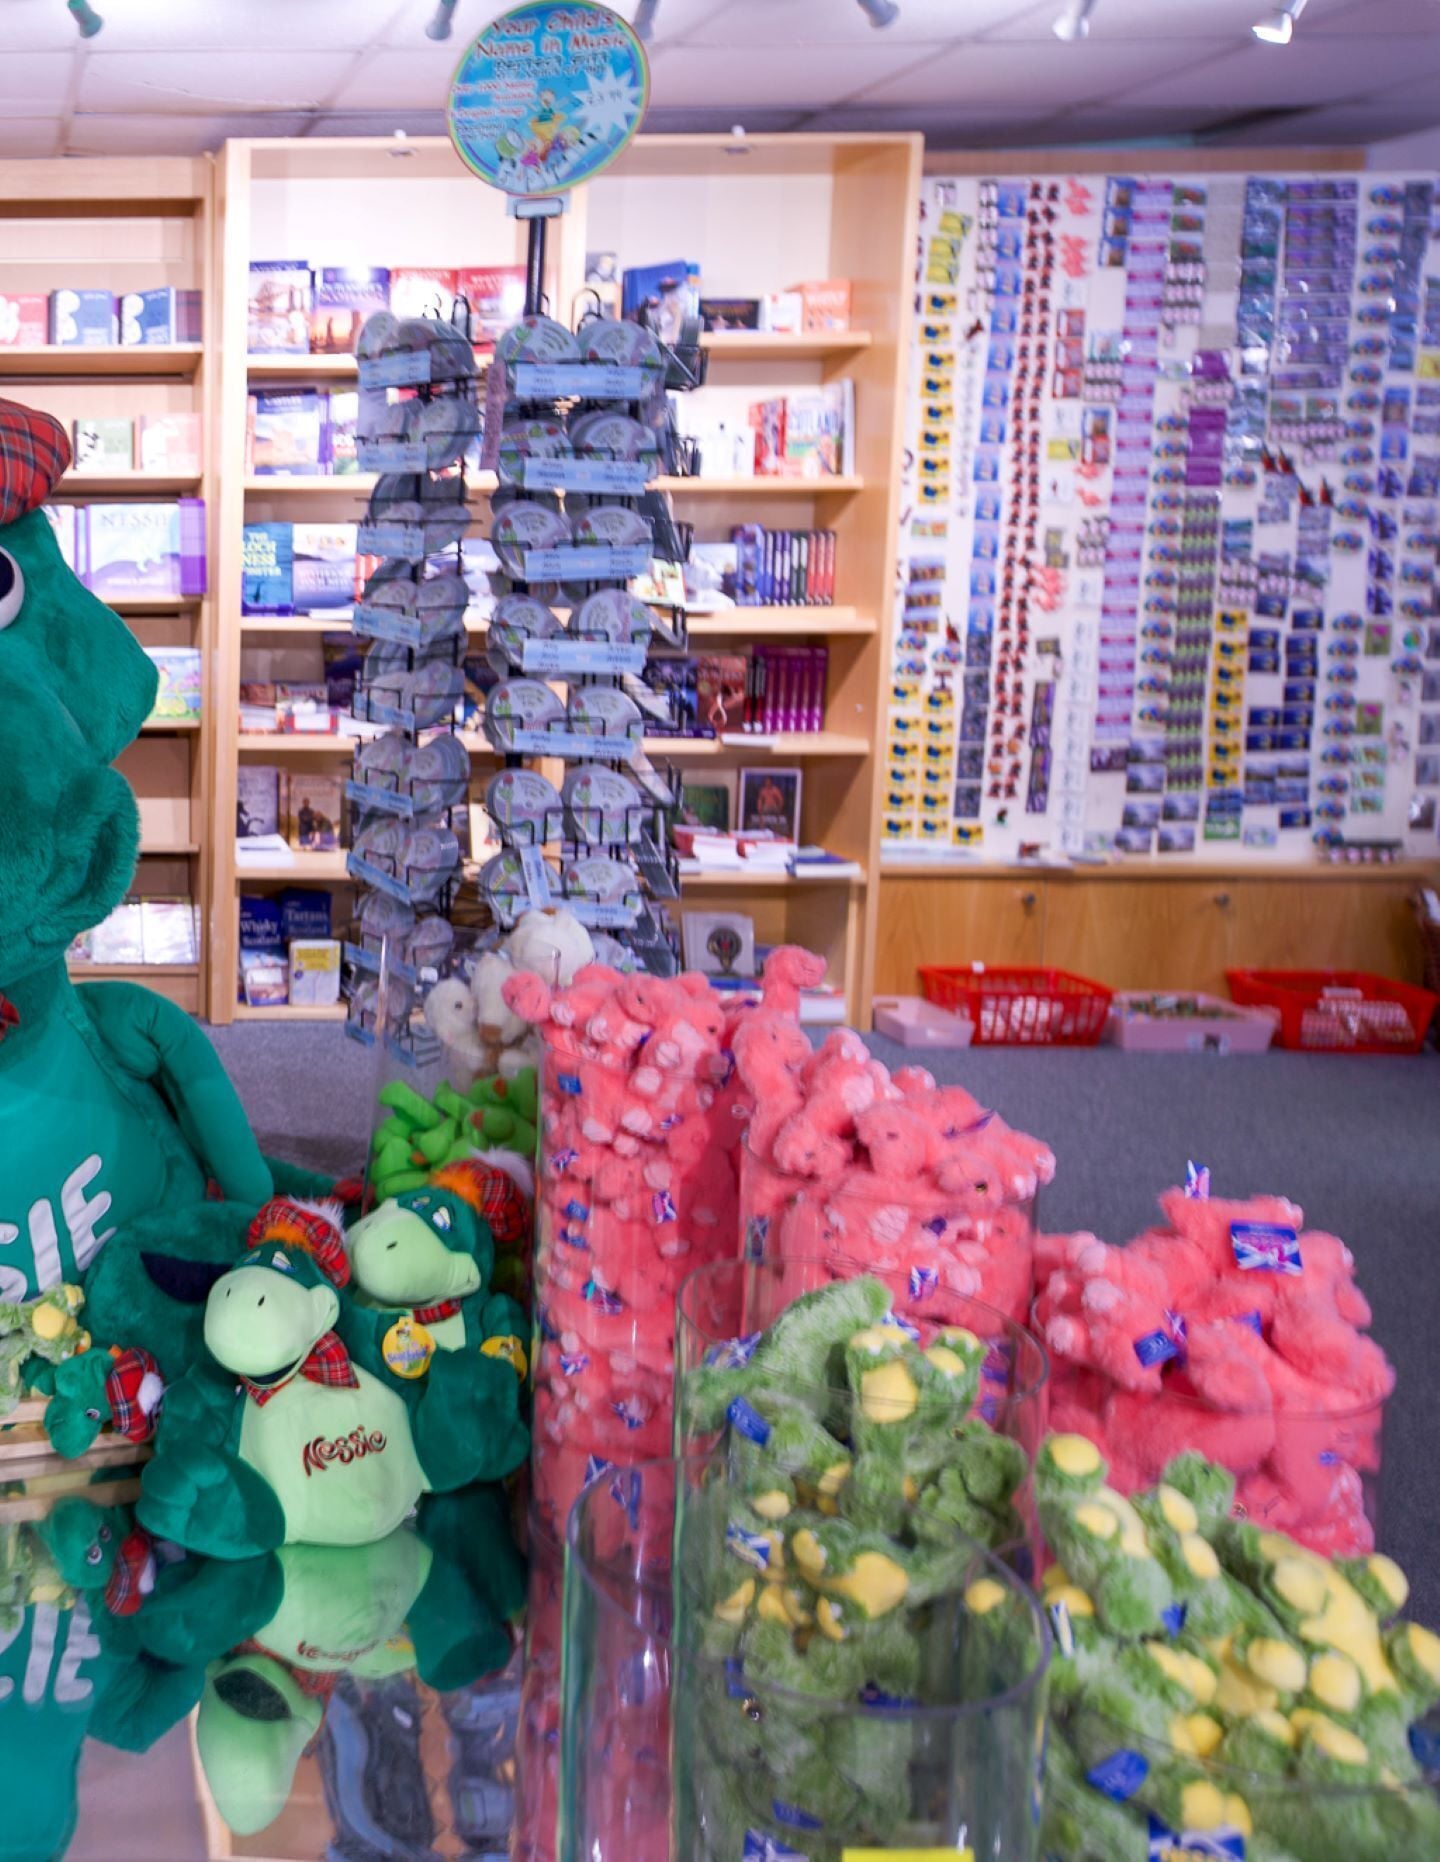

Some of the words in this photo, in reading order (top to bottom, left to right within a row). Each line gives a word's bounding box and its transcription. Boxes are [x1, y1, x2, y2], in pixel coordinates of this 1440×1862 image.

[492, 18, 537, 34] Your
[547, 12, 614, 32] Child's
[476, 39, 532, 59] Name
[543, 35, 559, 52] in
[570, 33, 625, 49] Music
[303, 1425, 387, 1478] Nessie
